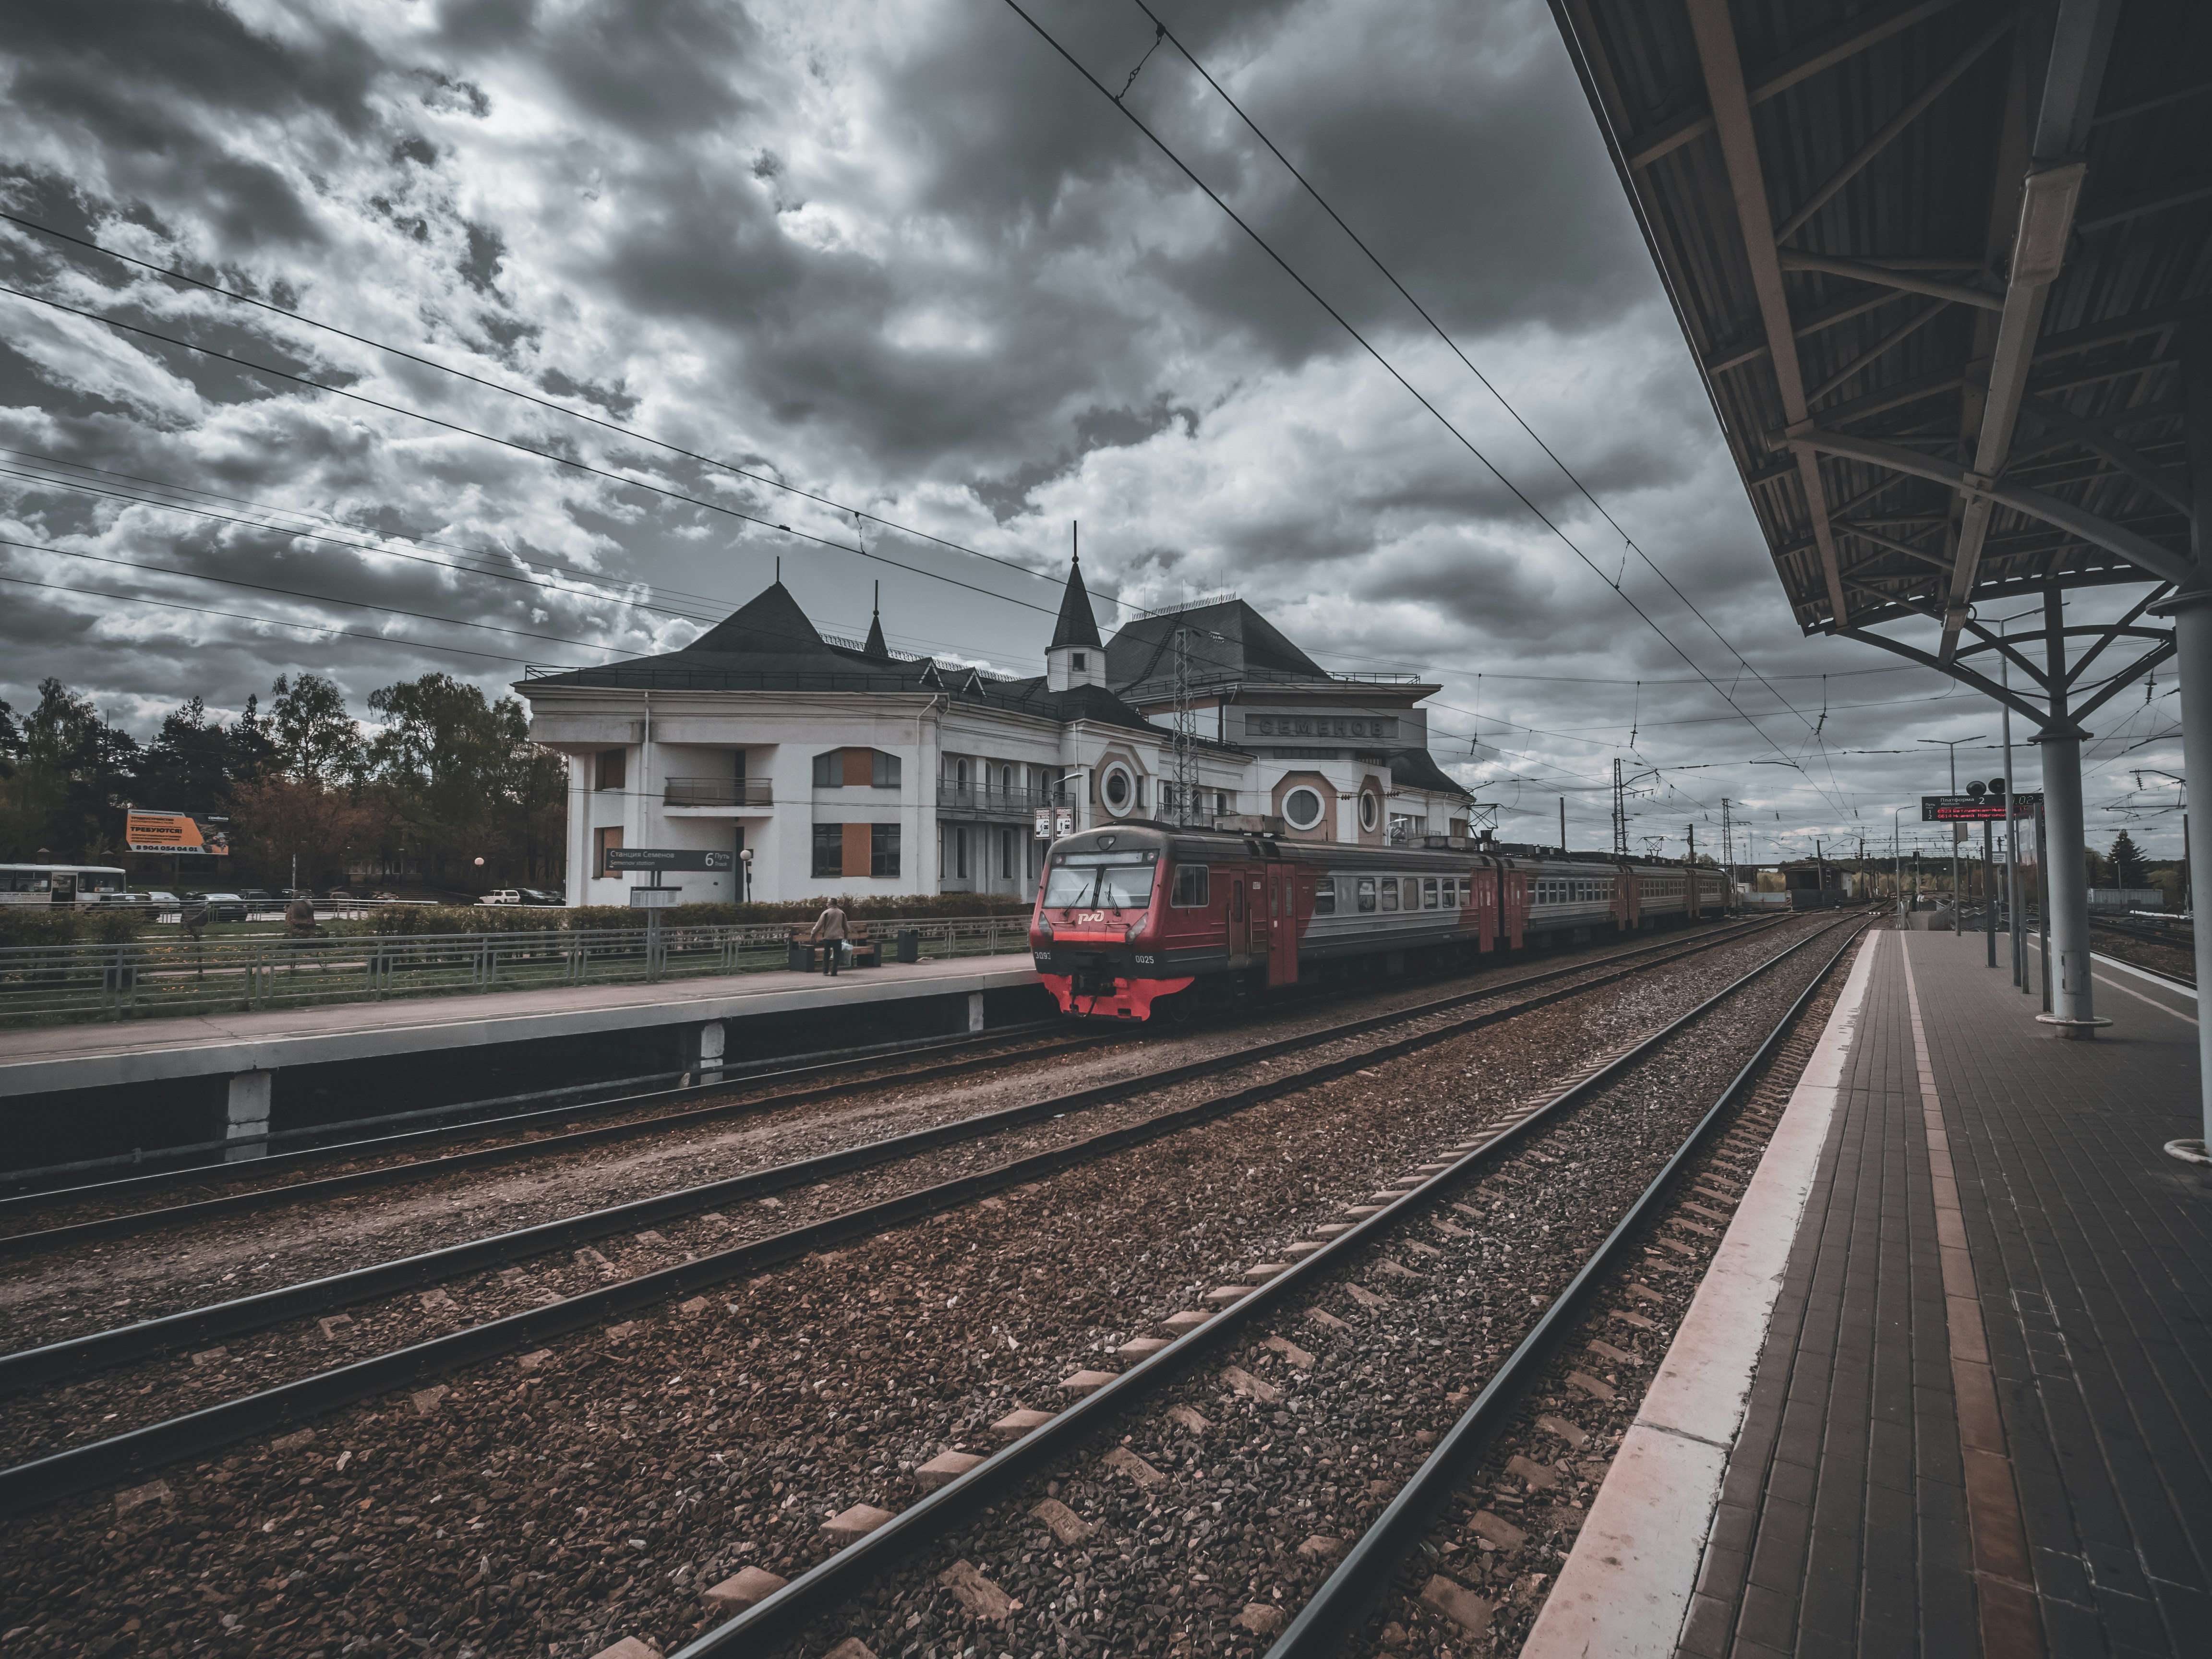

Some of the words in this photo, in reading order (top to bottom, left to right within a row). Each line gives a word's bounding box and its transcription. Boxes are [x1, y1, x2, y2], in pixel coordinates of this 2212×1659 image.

[1260, 719, 1383, 736] СЕМЕНОВ
[705, 853, 714, 866] 6
[1135, 955, 1154, 964] 0025
